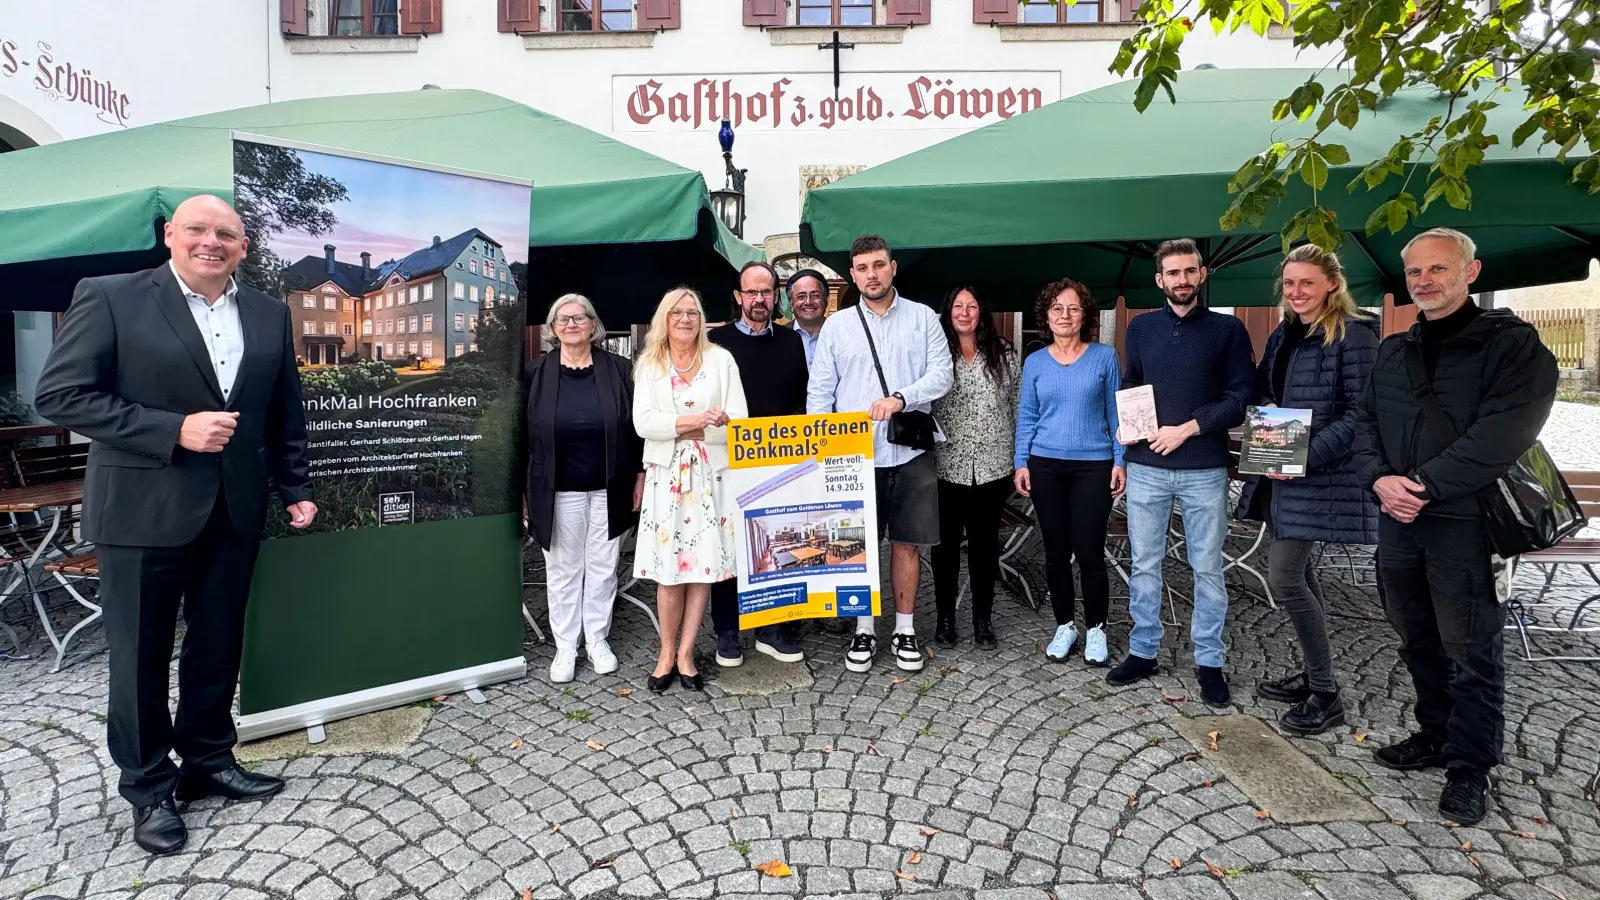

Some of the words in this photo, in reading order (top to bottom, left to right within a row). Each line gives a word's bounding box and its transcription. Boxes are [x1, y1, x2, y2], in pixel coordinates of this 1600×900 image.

[627, 77, 792, 129] Gasthof
[791, 95, 815, 127] z.
[903, 75, 1042, 120] Löwen
[302, 394, 363, 411] nkMal
[369, 393, 477, 409] Hochfranken
[355, 418, 427, 430] Sanierungen
[732, 424, 763, 445] Tag
[768, 422, 798, 440] des
[803, 418, 869, 438] offenen
[350, 437, 381, 446] Gerhard
[382, 436, 417, 445] Schlötzer
[417, 435, 431, 443] und
[432, 434, 460, 442] Gerhard
[460, 433, 483, 442] Hagen
[361, 451, 419, 462] ArchitekturTreff
[420, 449, 463, 459] Hochfranken
[824, 454, 864, 466] Wert-voll:
[343, 463, 418, 475] Architektenkammer
[825, 474, 858, 484] Sonntag
[825, 483, 864, 493] 14.9.2025
[383, 494, 401, 504] seh
[764, 506, 786, 515] Gasthof
[798, 504, 824, 512] Goldenen
